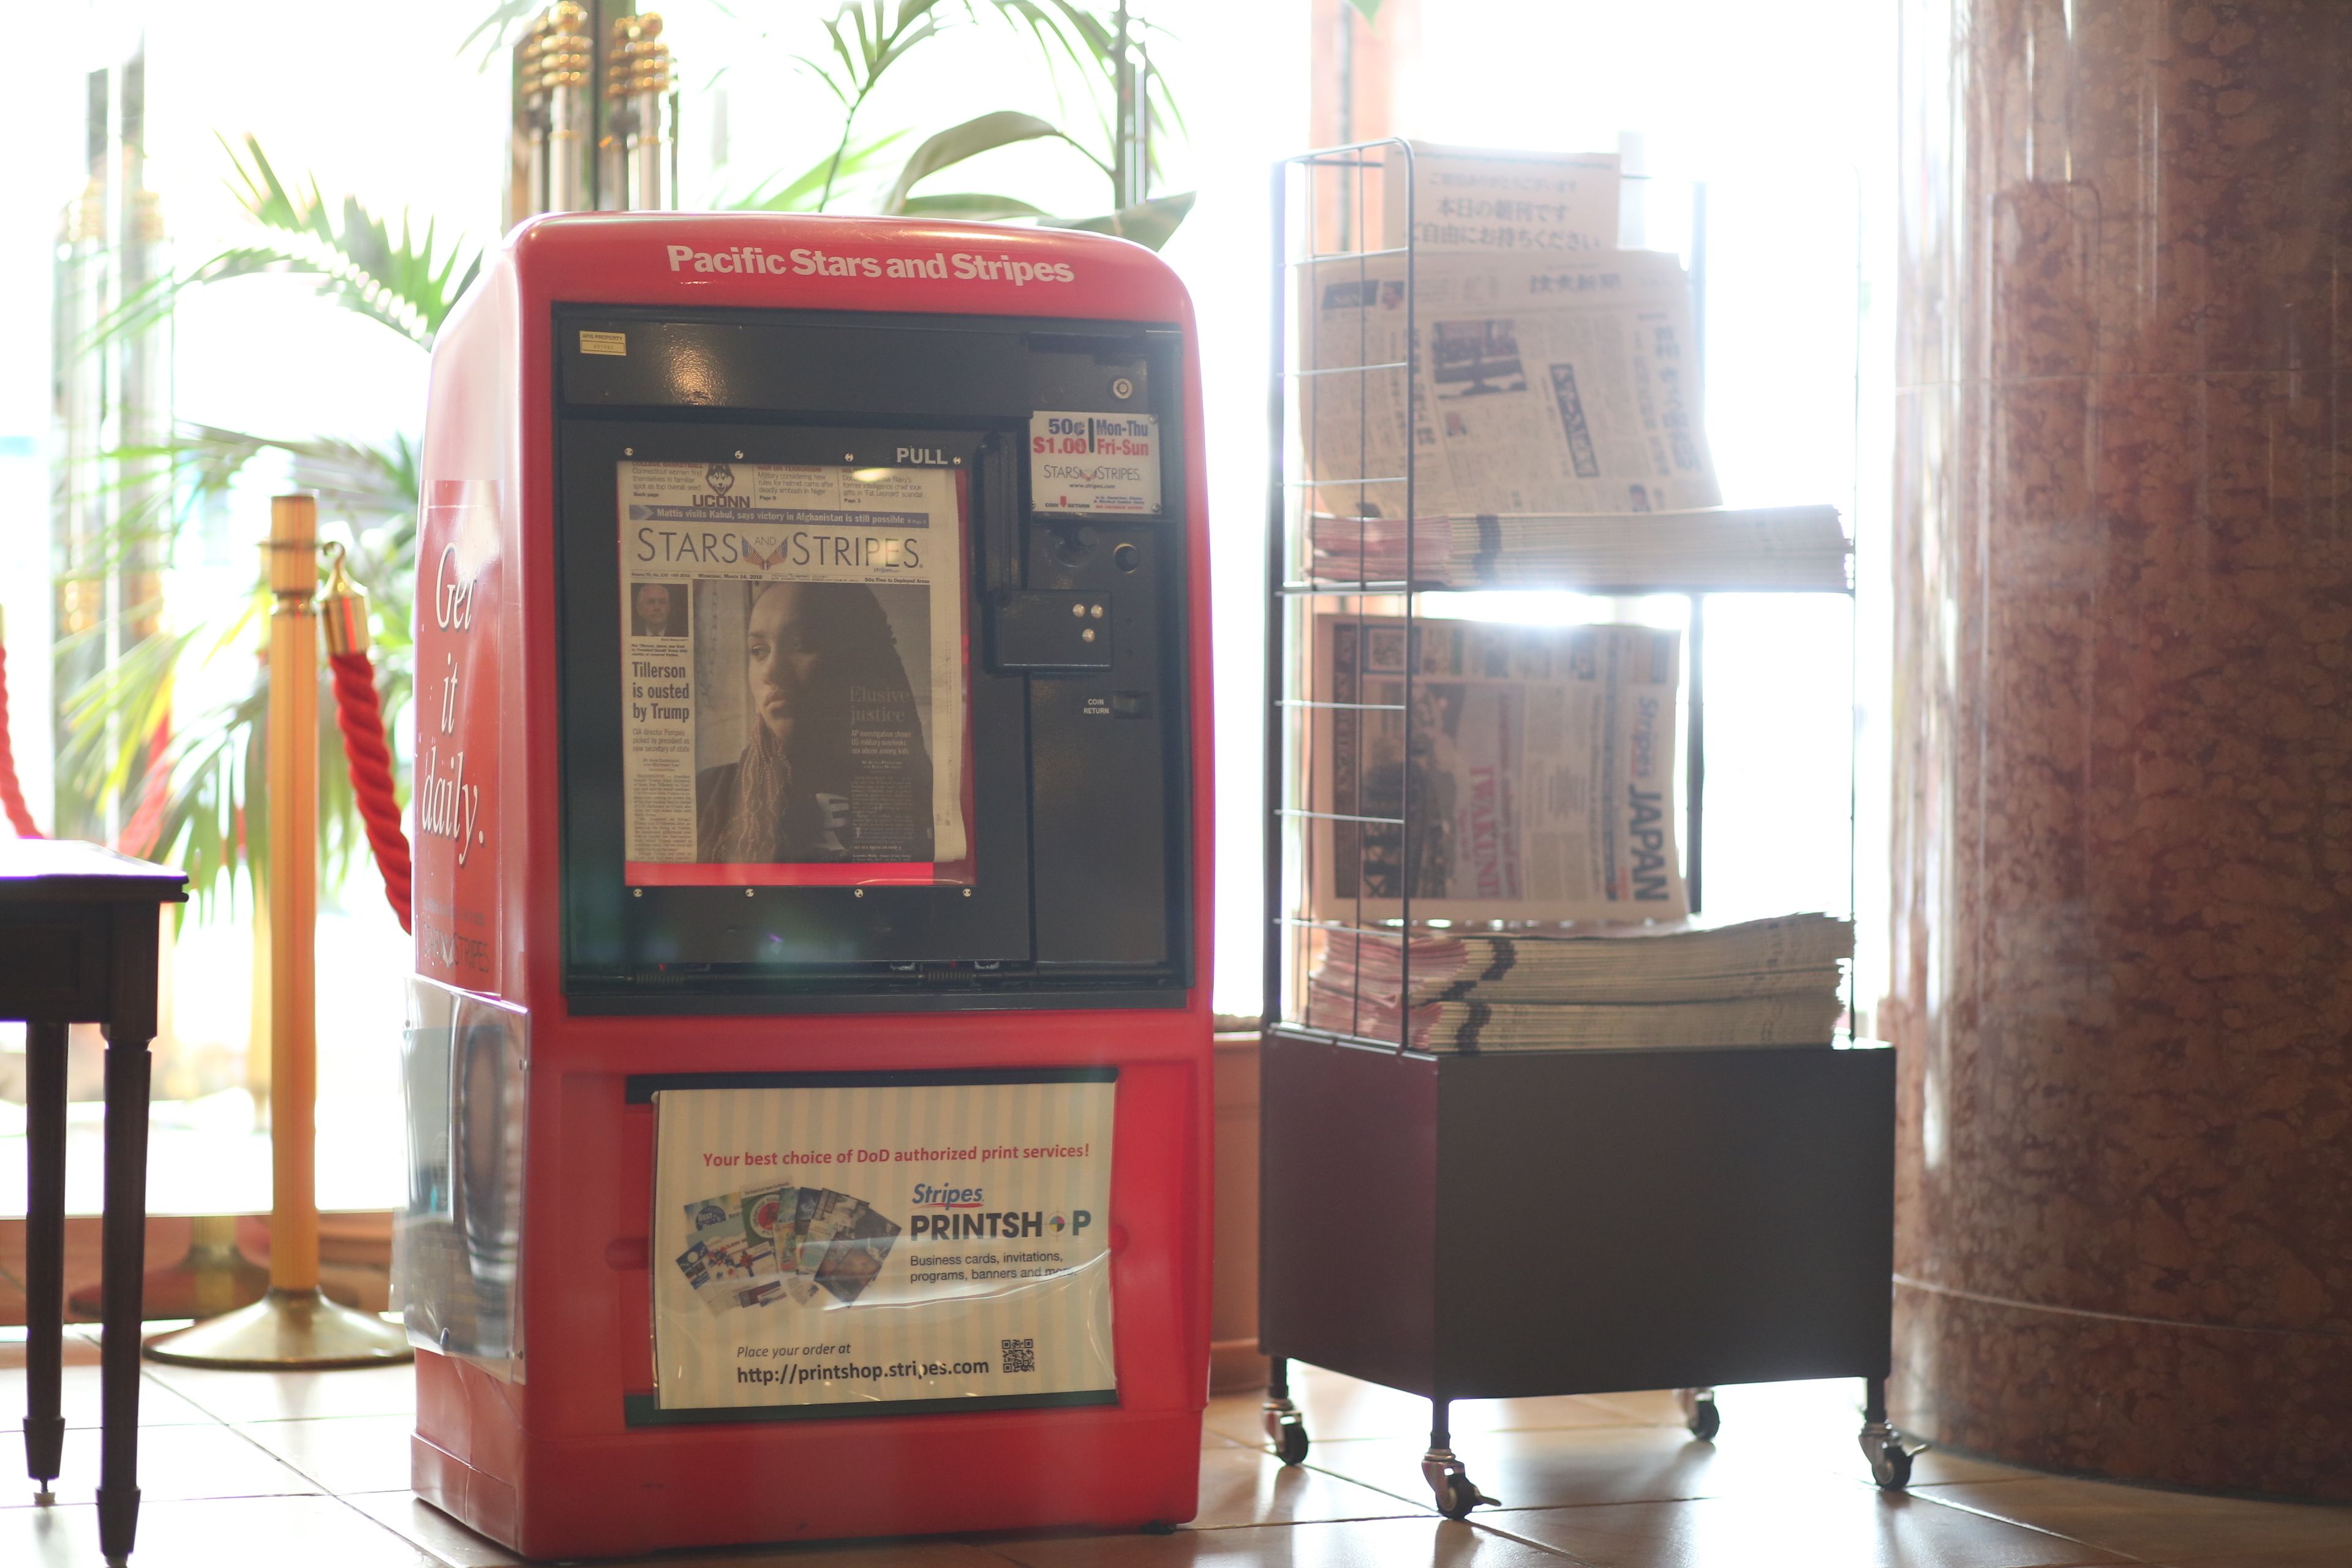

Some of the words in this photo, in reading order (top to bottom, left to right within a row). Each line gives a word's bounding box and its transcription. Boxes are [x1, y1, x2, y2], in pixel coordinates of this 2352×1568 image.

[666, 245, 786, 274] Pacific
[790, 248, 882, 278] Stars
[886, 253, 948, 279] and
[951, 253, 1075, 286] Stripes
[1049, 418, 1085, 436] 50¢
[1096, 420, 1148, 437] Mon-Thu
[1033, 436, 1087, 454] $1.00
[1097, 438, 1149, 456] Fri-Sun
[896, 448, 948, 465] PULL
[1044, 465, 1080, 479] STARS
[1097, 466, 1140, 481] STRIPES
[692, 495, 750, 508] UCONN
[657, 509, 683, 518] Mattis
[685, 509, 707, 518] visits
[709, 510, 734, 520] Kabul,
[757, 512, 784, 521] victory
[796, 513, 843, 524] Afghanistan
[854, 514, 870, 522] still
[872, 514, 905, 525] possible
[638, 527, 737, 564] STARS
[754, 537, 777, 546] AND
[632, 662, 685, 678] Tillerson
[441, 652, 458, 734] it
[633, 682, 643, 698] is
[647, 683, 689, 699] ousted
[850, 686, 910, 703] Elusive
[633, 703, 647, 722] by
[651, 703, 690, 723] Trump
[850, 705, 905, 725] justice
[1630, 696, 1660, 778] Stripes
[421, 745, 484, 865] daily.
[1629, 783, 1670, 902] JAPAN
[703, 1153, 740, 1167] Your
[745, 1152, 777, 1166] best
[782, 1150, 832, 1164] choice
[836, 1149, 853, 1163] of
[858, 1149, 889, 1163] DoD
[894, 1147, 977, 1161] authorized
[982, 1145, 1019, 1163] print
[1023, 1144, 1089, 1158] services!
[912, 1183, 983, 1210] Stripes
[910, 1255, 962, 1266] Business
[965, 1254, 1000, 1265] cards,
[1003, 1251, 1063, 1264] invitations,
[910, 1270, 968, 1284] programs,
[971, 1268, 1017, 1280] banners
[1020, 1267, 1041, 1278] and
[737, 1346, 769, 1358] Place
[772, 1348, 799, 1359] your
[802, 1343, 835, 1355] order
[838, 1343, 851, 1354] at
[737, 1360, 989, 1384] http://printshop.stripes.com
